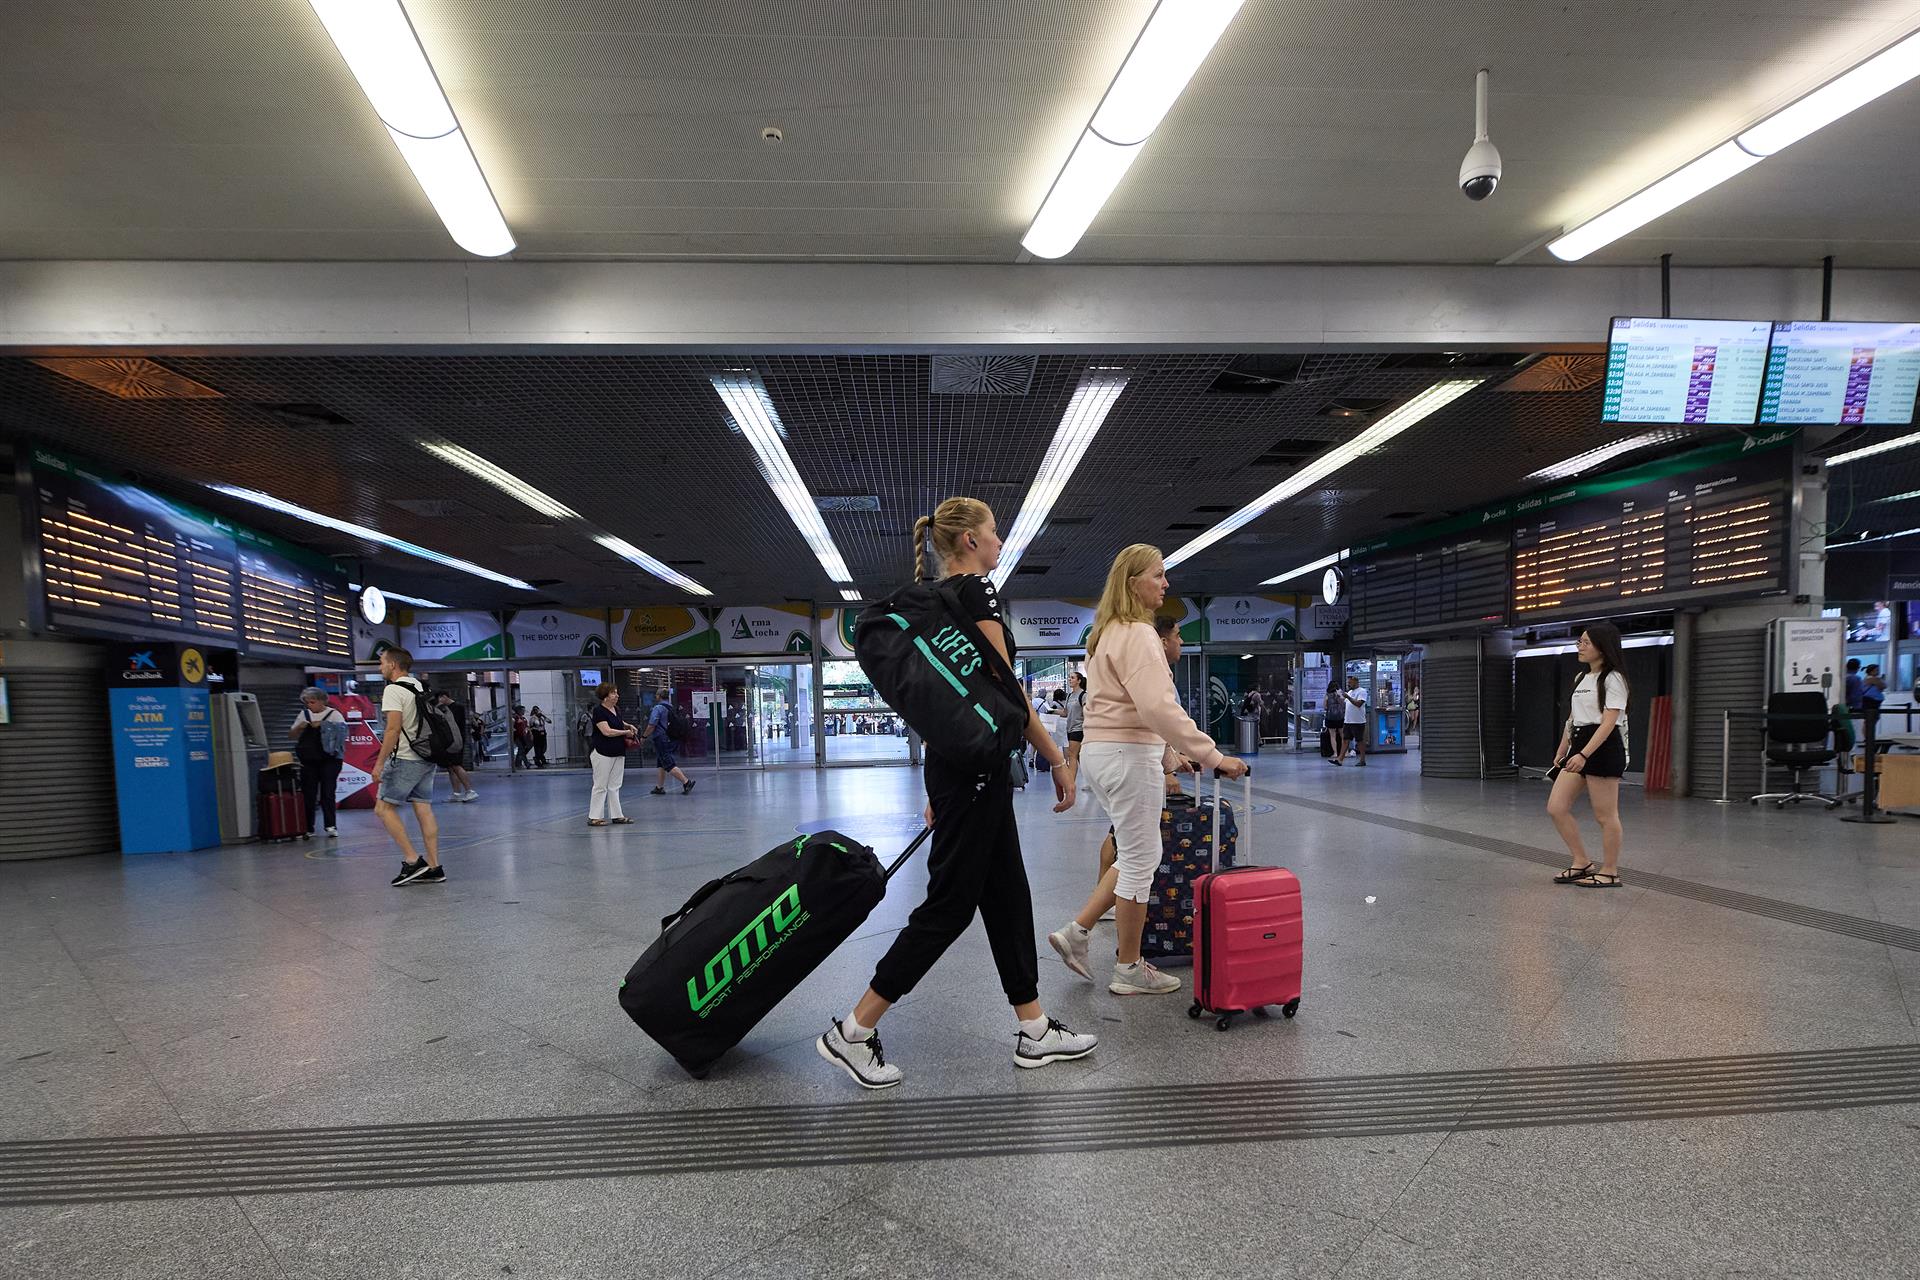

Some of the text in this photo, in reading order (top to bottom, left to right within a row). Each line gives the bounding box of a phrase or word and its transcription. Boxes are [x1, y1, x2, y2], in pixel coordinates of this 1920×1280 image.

[1516, 498, 1542, 512] Salidas
[1020, 616, 1080, 625] GASTROTECA
[634, 624, 666, 632] tiendas
[931, 626, 982, 676] LIFE'S
[122, 672, 162, 680] CaixaBank
[134, 713, 164, 722] ATM
[687, 883, 801, 1011] LOTTO
[699, 910, 811, 1019] SPORT PERFORMANCE
